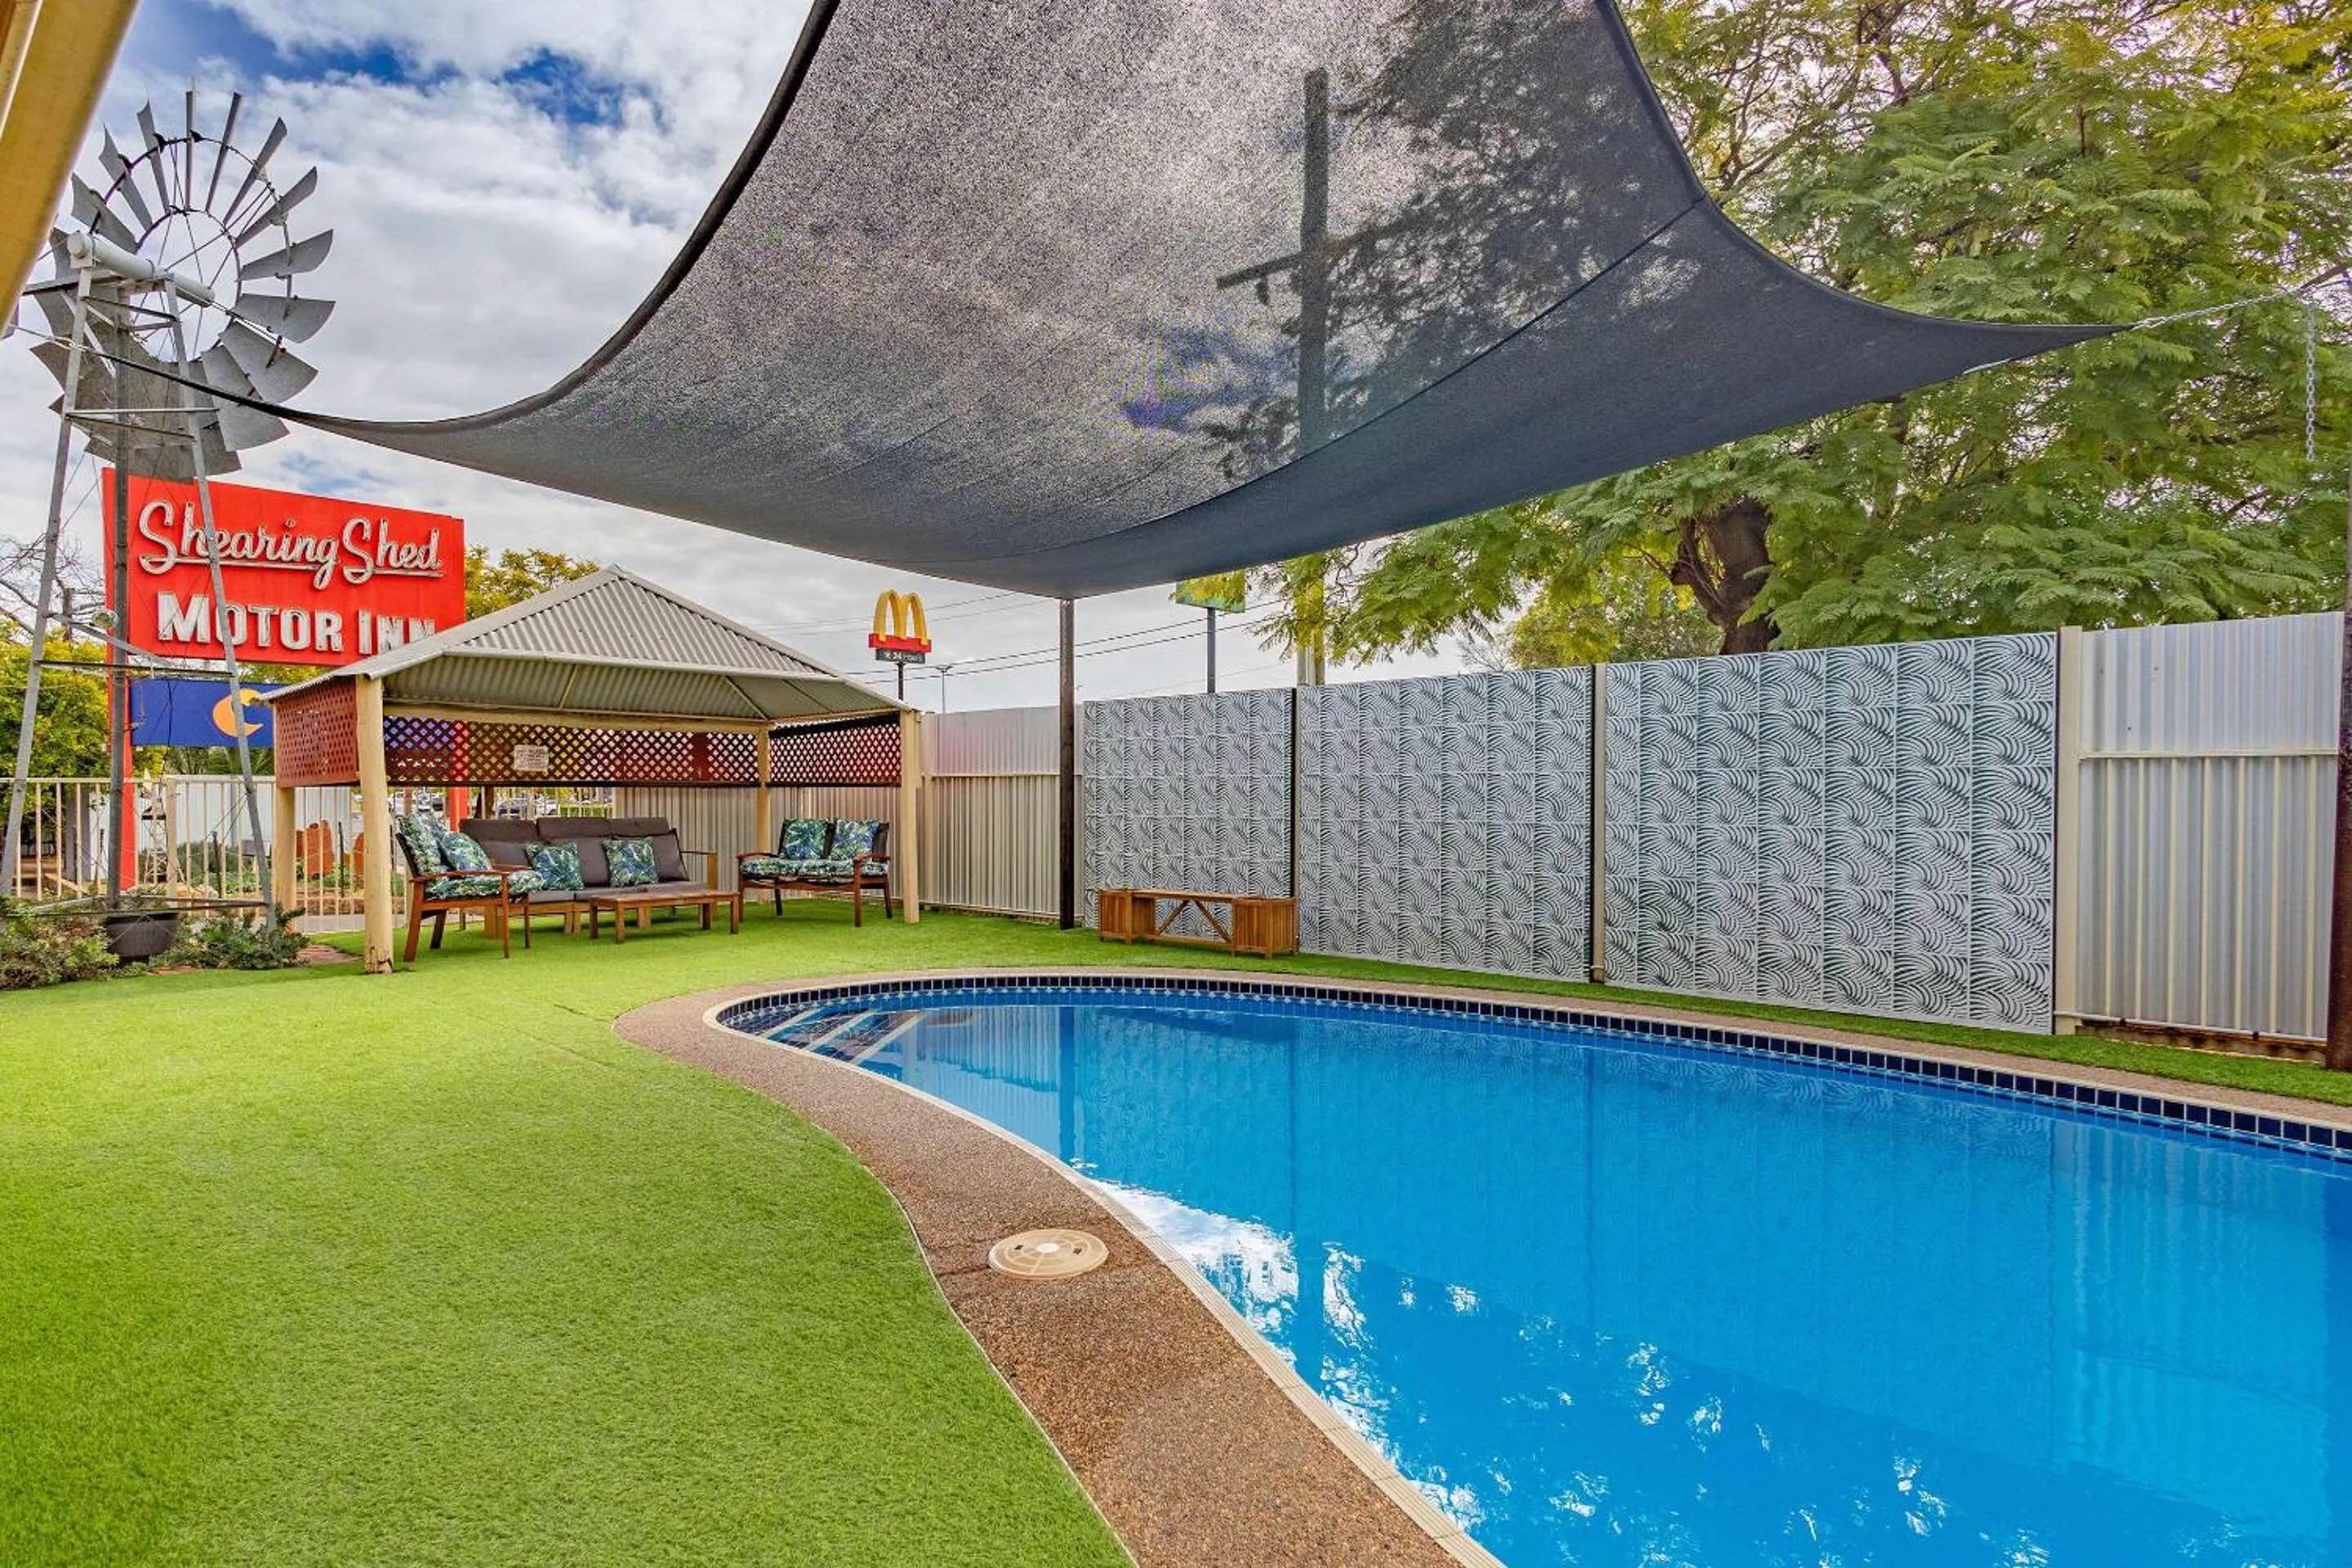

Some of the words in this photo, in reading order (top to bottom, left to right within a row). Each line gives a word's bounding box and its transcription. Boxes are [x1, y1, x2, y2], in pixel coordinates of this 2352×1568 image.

[139, 501, 340, 590] Shearing
[342, 517, 444, 585] Shed
[158, 590, 345, 653] MOTOR
